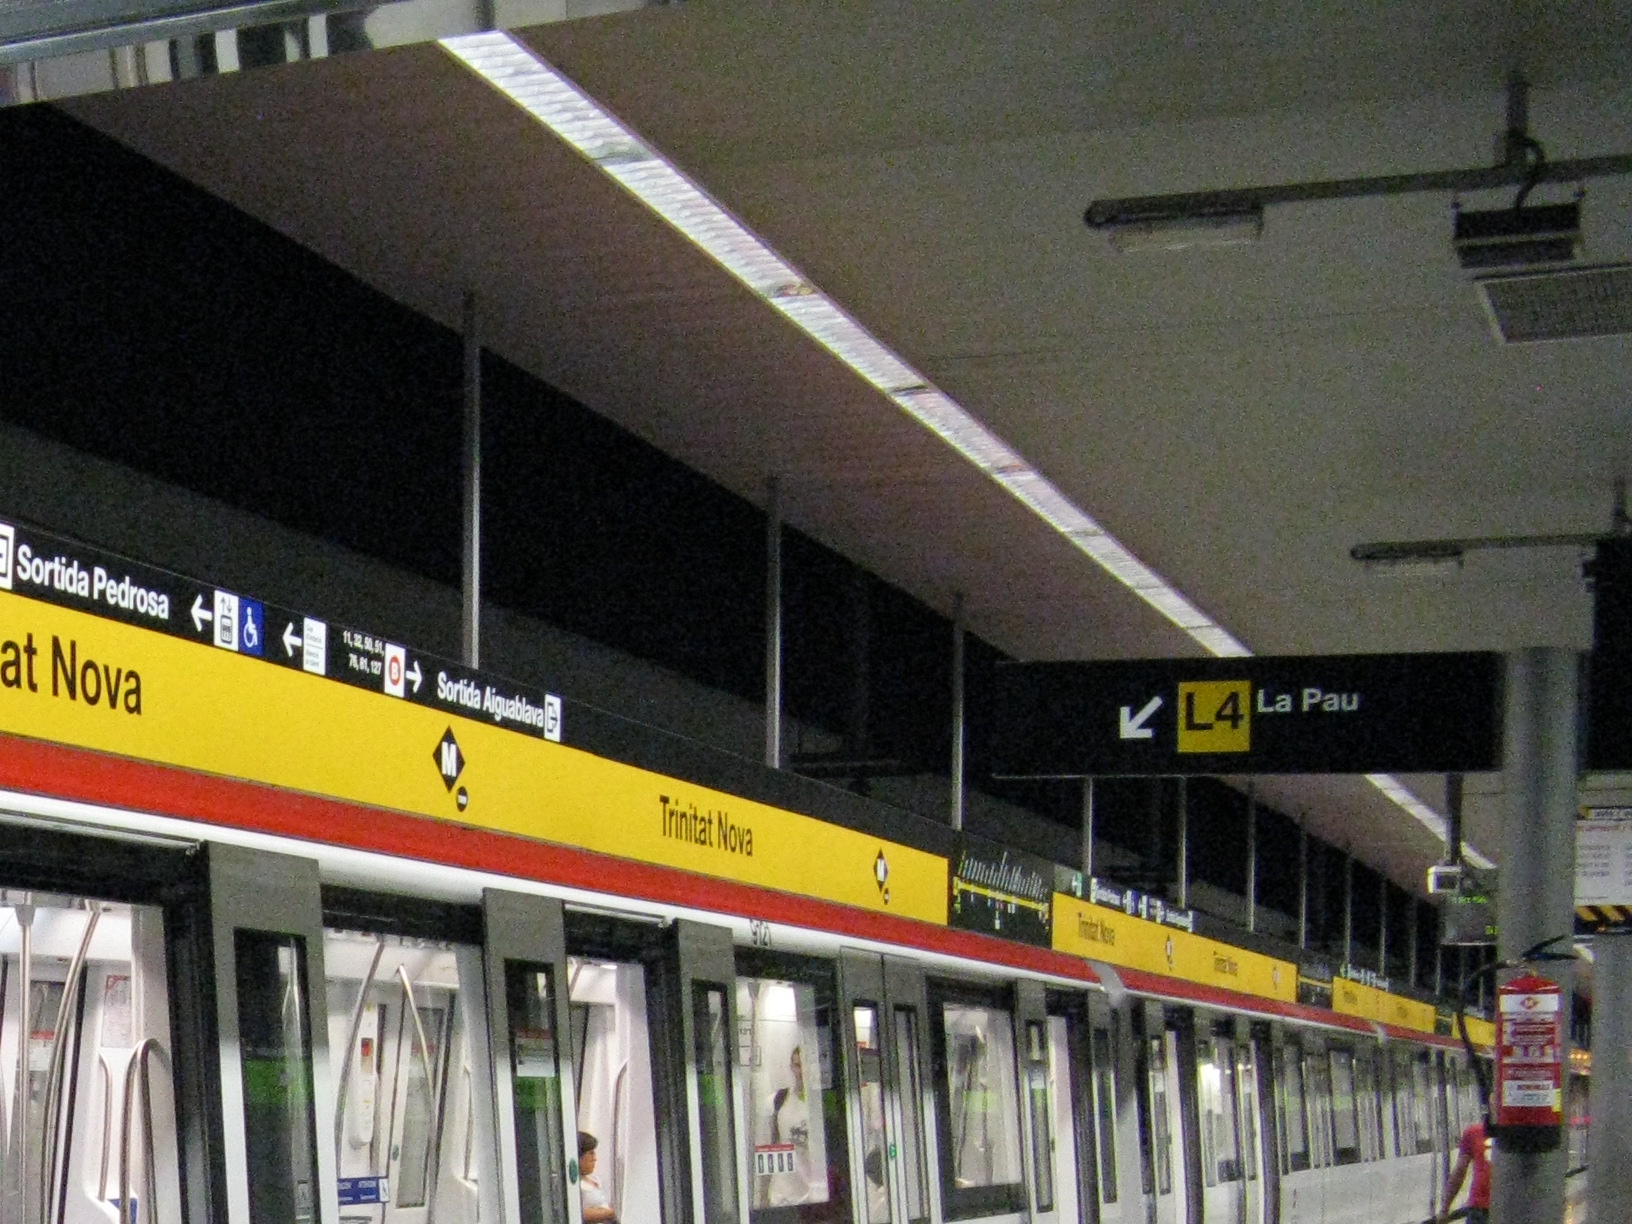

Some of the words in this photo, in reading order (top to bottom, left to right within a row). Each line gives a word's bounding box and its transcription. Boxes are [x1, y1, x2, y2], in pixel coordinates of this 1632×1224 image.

[16, 545, 89, 597] Sortida
[93, 567, 170, 620] Pedrosa
[51, 634, 143, 715] Nova
[437, 670, 481, 709] Sortida
[483, 686, 544, 728] Aiguablava
[1257, 689, 1292, 713] La
[1302, 688, 1359, 712] Pau
[1184, 691, 1244, 731] L4
[441, 741, 457, 777] M
[659, 794, 714, 848] Trinitat
[717, 810, 753, 857] Nova
